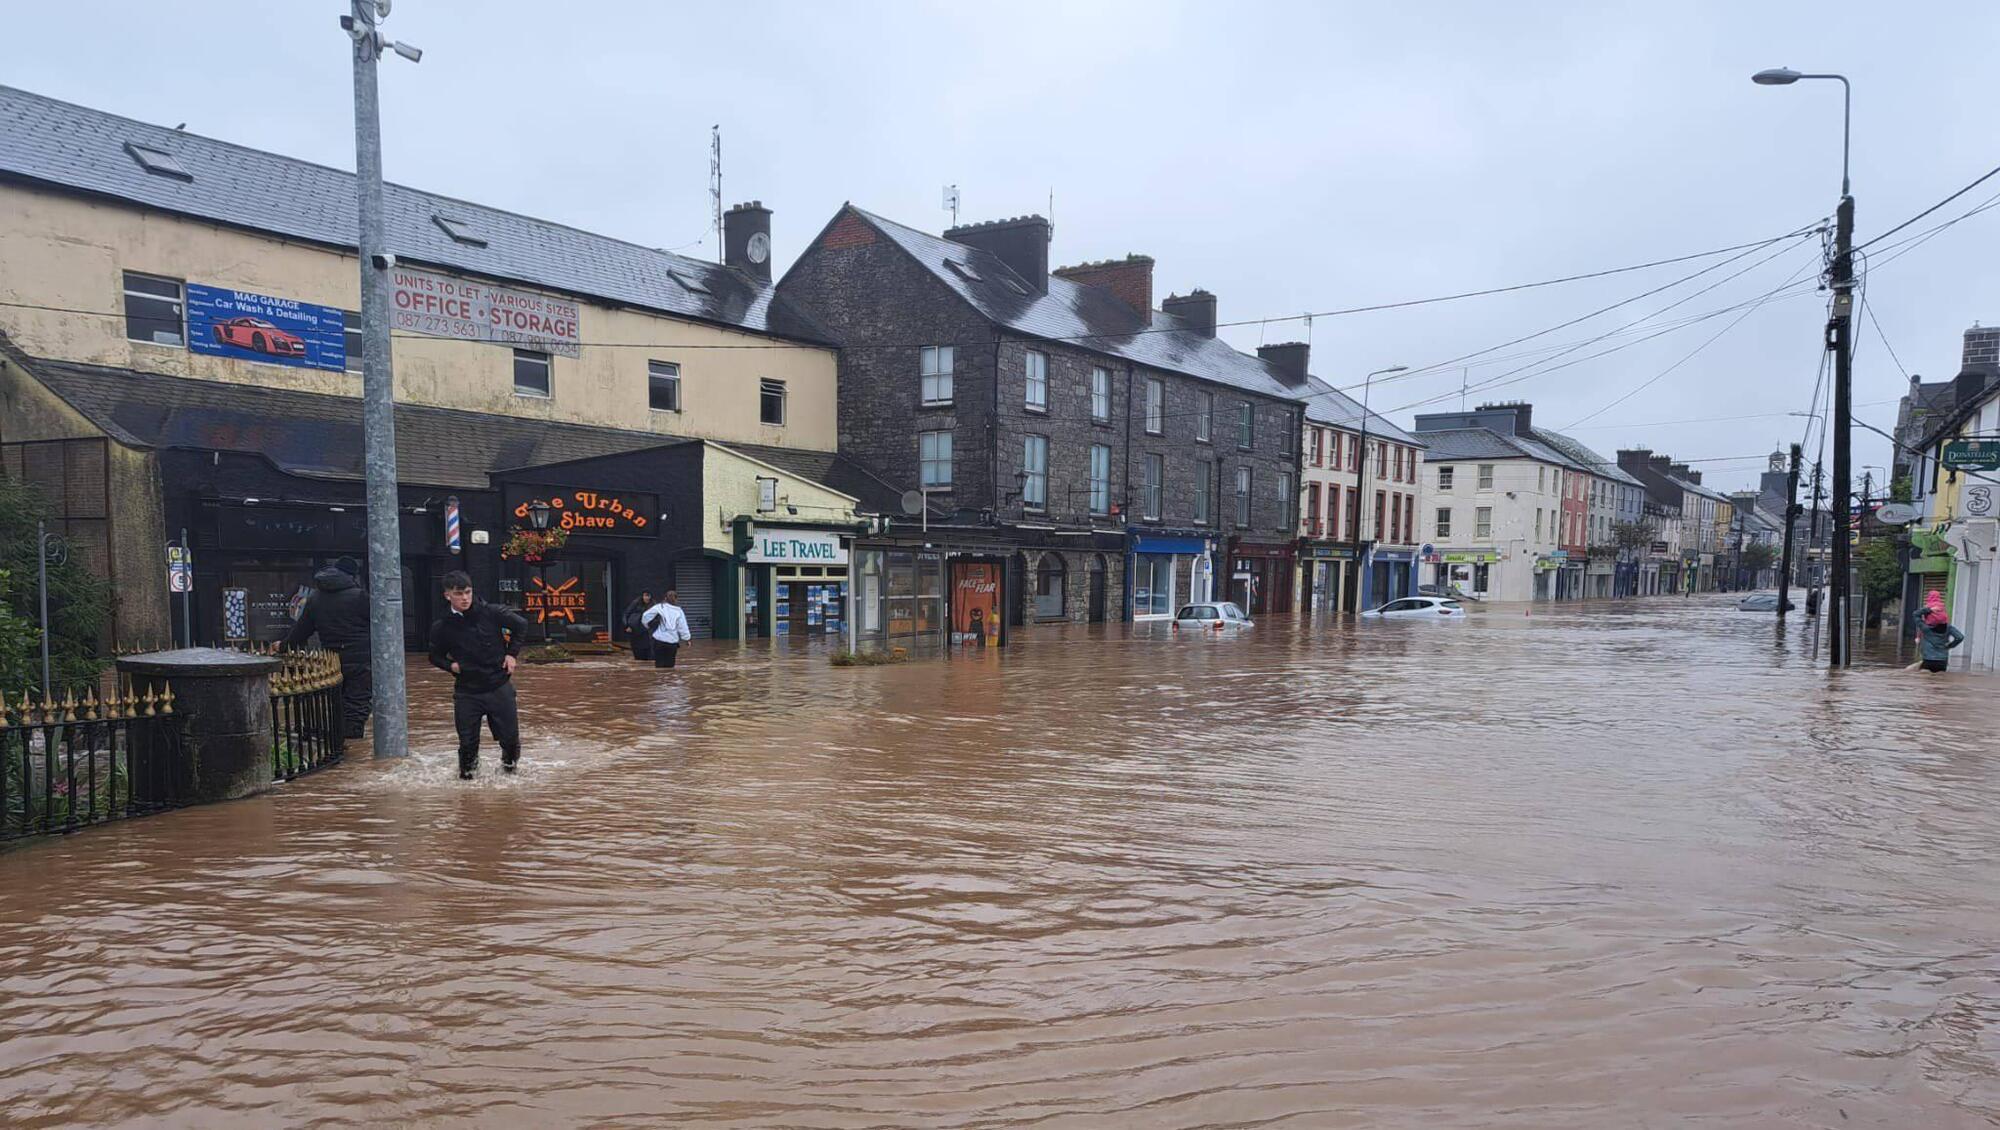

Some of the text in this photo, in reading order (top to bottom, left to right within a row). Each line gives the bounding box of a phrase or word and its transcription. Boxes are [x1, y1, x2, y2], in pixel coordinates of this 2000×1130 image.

[233, 291, 300, 310] MAG GARAGE
[394, 273, 433, 291] UNITS
[437, 281, 454, 295] TO
[459, 285, 480, 300] LET
[490, 292, 543, 311] VARIOUS
[546, 303, 577, 319] SIZES
[215, 298, 233, 309] Car
[236, 301, 263, 314] Wash
[266, 306, 273, 316] &
[276, 308, 318, 325] Detailing
[395, 290, 577, 339] OFFICE STORAGE
[397, 312, 421, 328] 087
[425, 314, 448, 332] 273
[514, 492, 647, 527] Te Urban
[1967, 486, 1992, 513] 3
[560, 511, 615, 529] Shave
[763, 539, 837, 559] LEE TRAVEL
[975, 582, 996, 593] FEAR
